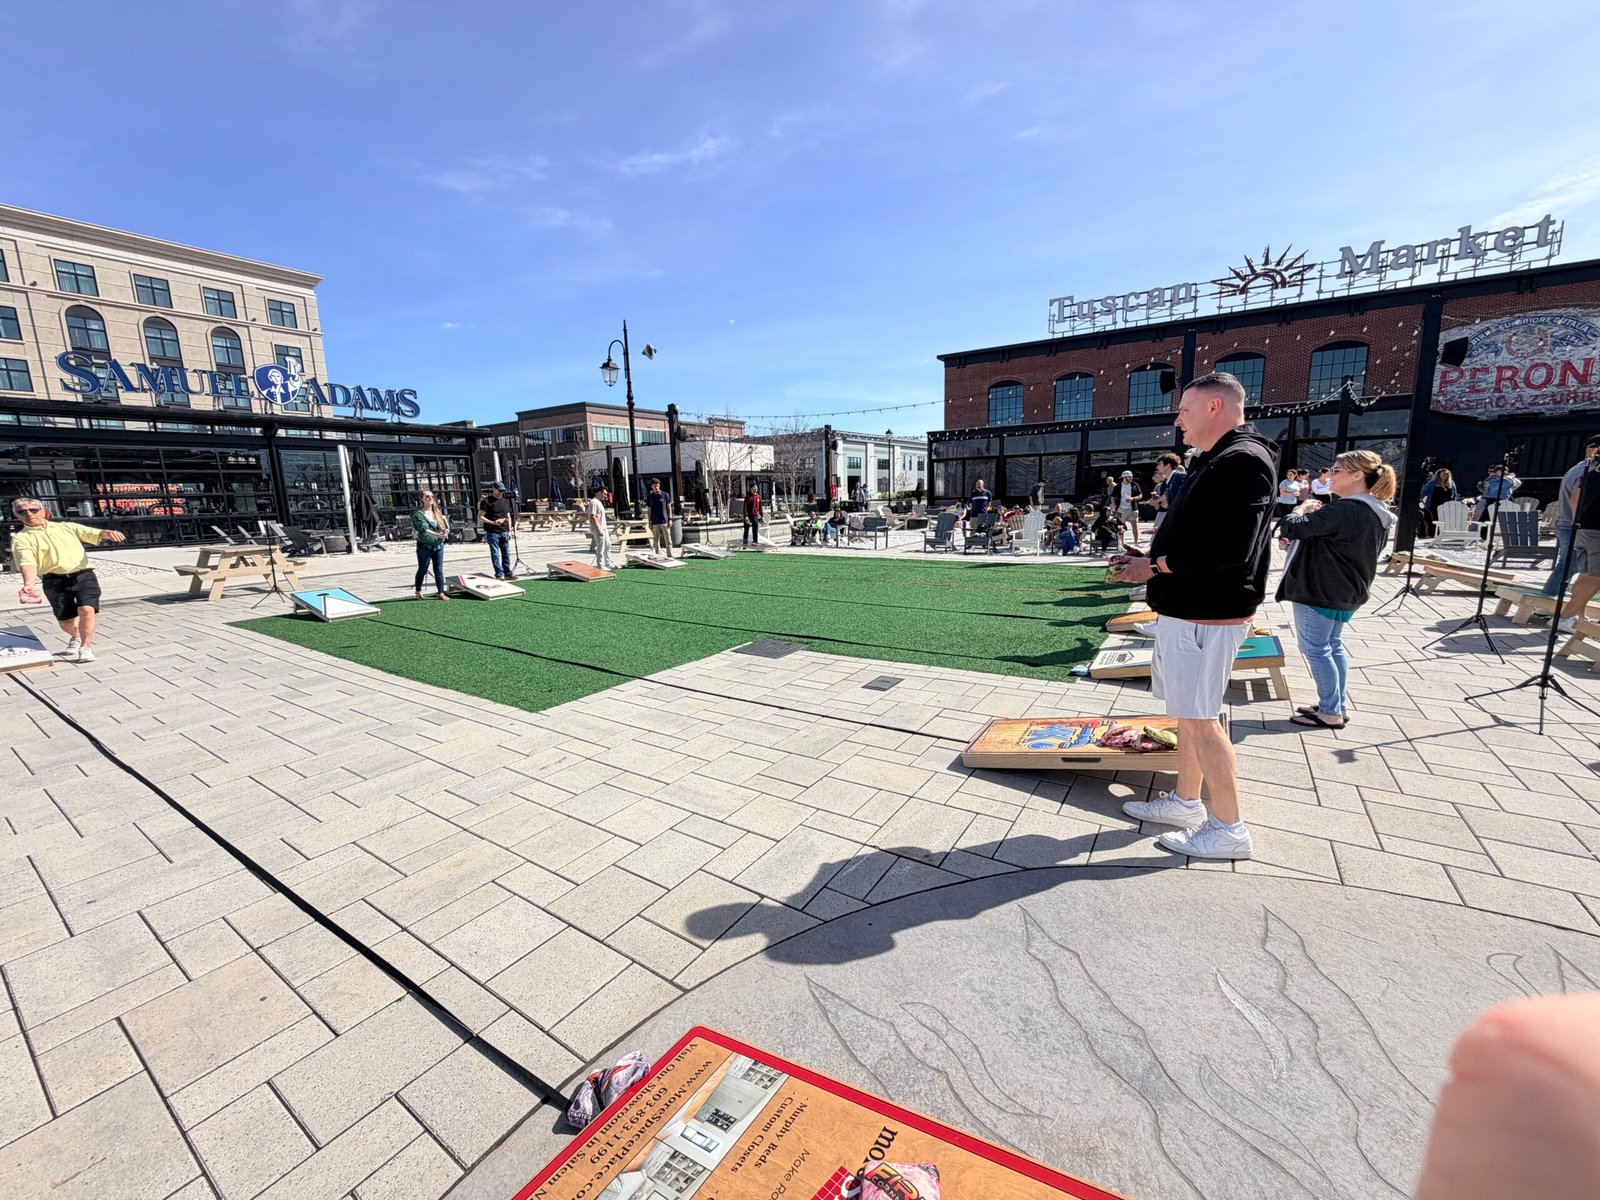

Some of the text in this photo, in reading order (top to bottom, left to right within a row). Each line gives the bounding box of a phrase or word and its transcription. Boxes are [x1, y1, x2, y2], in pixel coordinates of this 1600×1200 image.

[1049, 214, 1556, 323] Tuscan Market
[55, 351, 420, 418] SAMUEL ADAMS
[1436, 358, 1600, 396] PERON
[656, 1064, 675, 1081] Our
[675, 1044, 698, 1061] Visit
[571, 1061, 712, 1200] www.MoreSpacePlace.co
[590, 1087, 668, 1164] 603-893-1199
[600, 1082, 656, 1135] Showroom
[586, 1137, 605, 1149] in
[731, 1097, 793, 1174] Custom Closets
[754, 1102, 808, 1169] Murphy Beds
[547, 1150, 585, 1186] Salem
[769, 1148, 810, 1200] Make Ro
[865, 1162, 926, 1200] FIR
